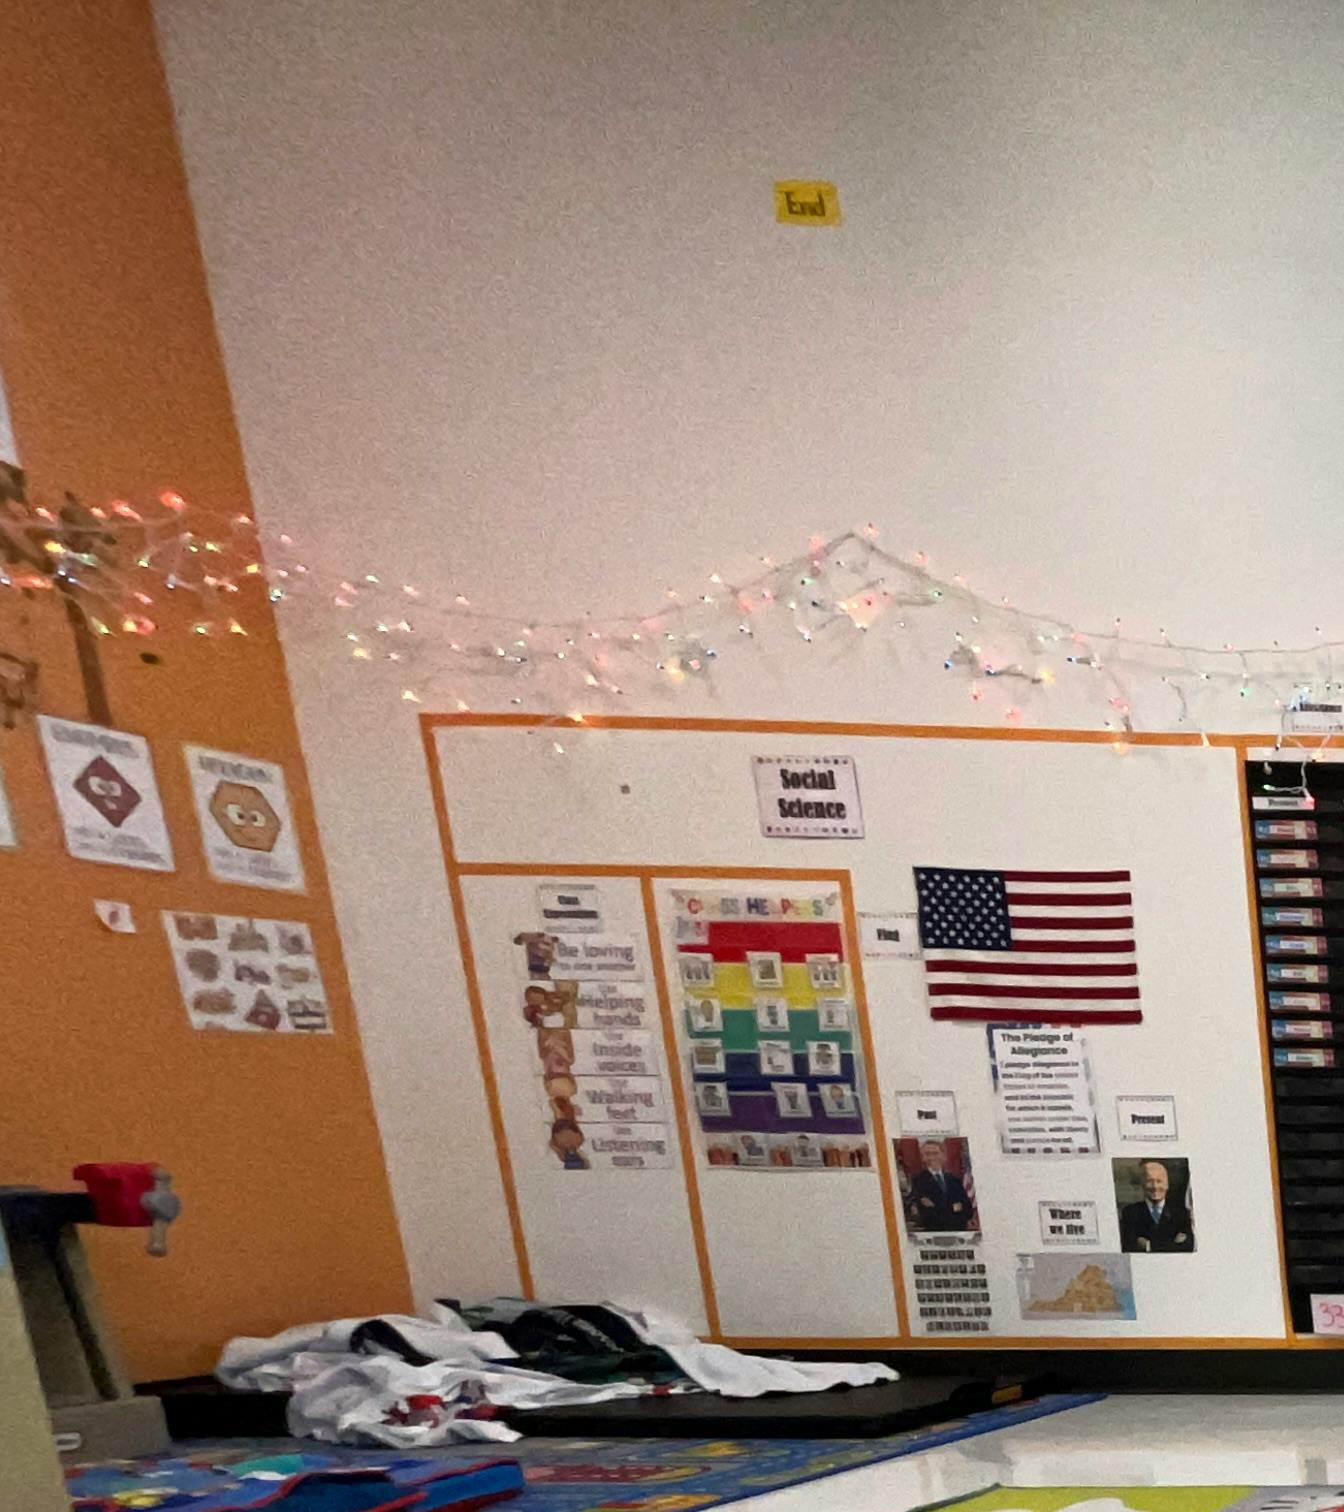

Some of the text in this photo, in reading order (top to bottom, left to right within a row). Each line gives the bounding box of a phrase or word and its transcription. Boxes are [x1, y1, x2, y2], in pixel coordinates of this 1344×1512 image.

[785, 191, 825, 217] End
[779, 768, 836, 791] Social
[777, 798, 847, 820] Science
[1049, 1207, 1082, 1221] Where
